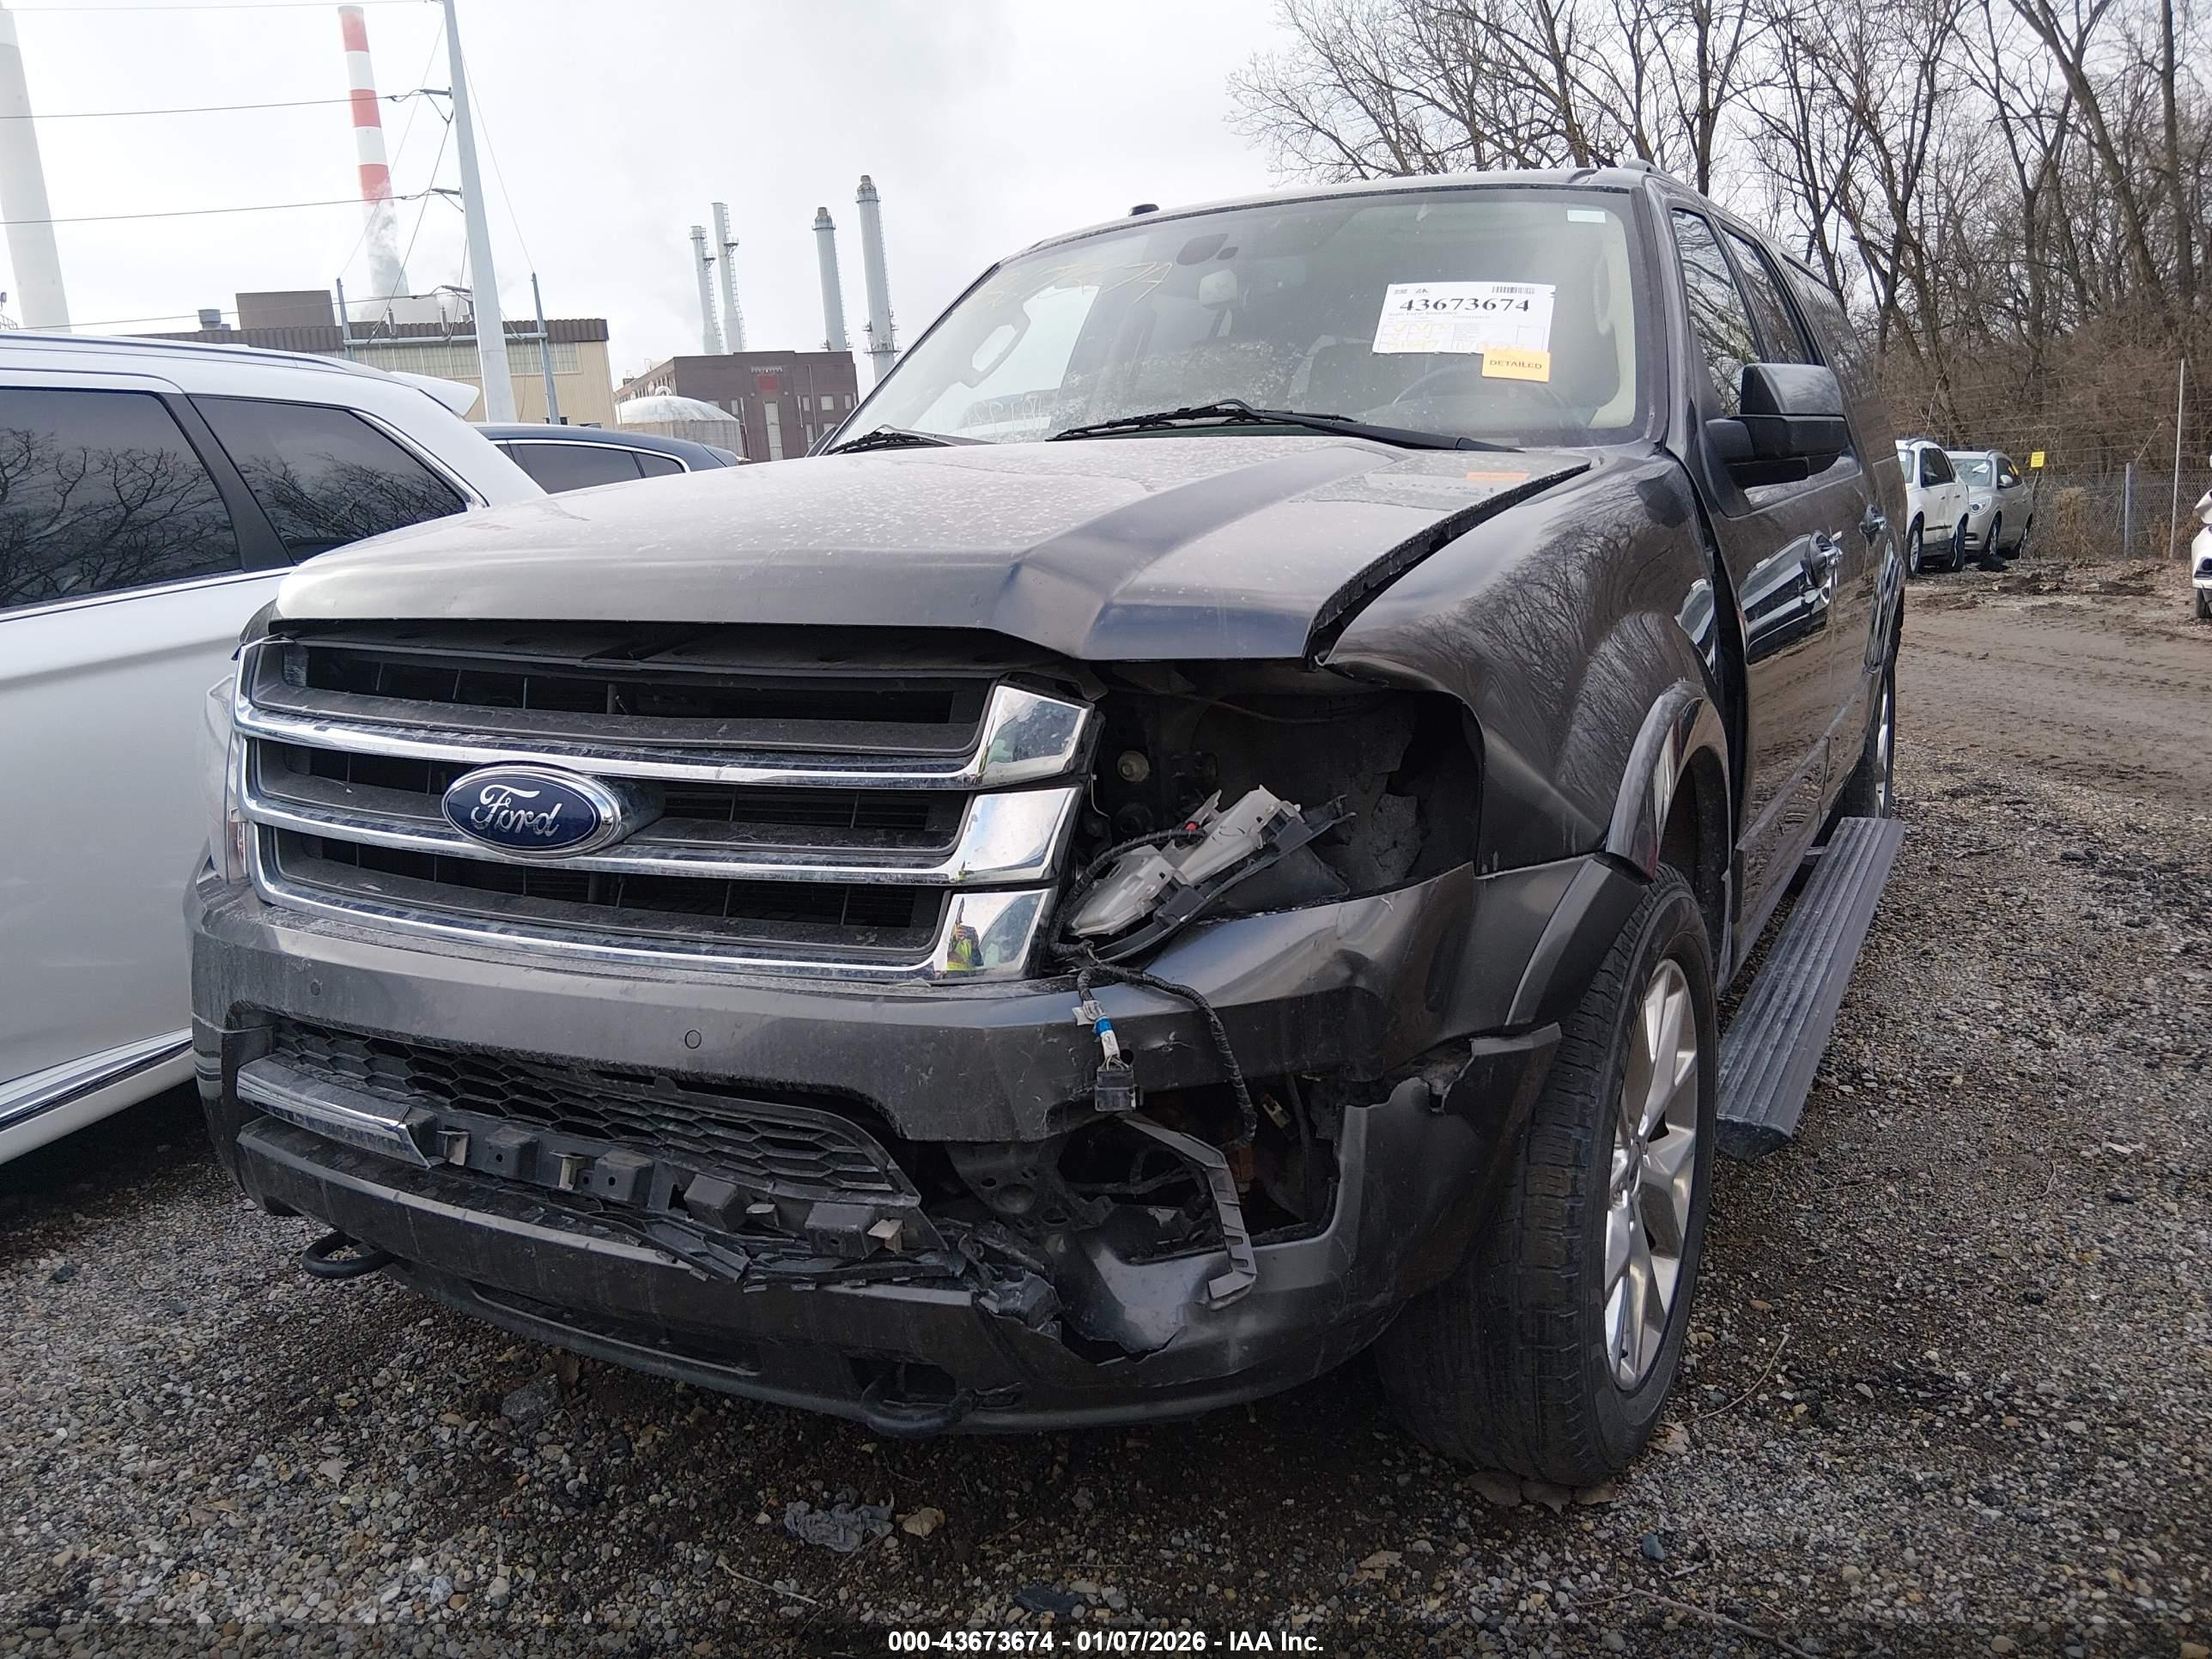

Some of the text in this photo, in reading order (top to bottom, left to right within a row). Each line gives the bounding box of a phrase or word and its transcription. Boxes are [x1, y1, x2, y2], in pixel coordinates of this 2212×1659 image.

[1399, 298, 1530, 313] 43673674
[1490, 359, 1542, 369] DETAILED
[470, 783, 563, 837] Ford
